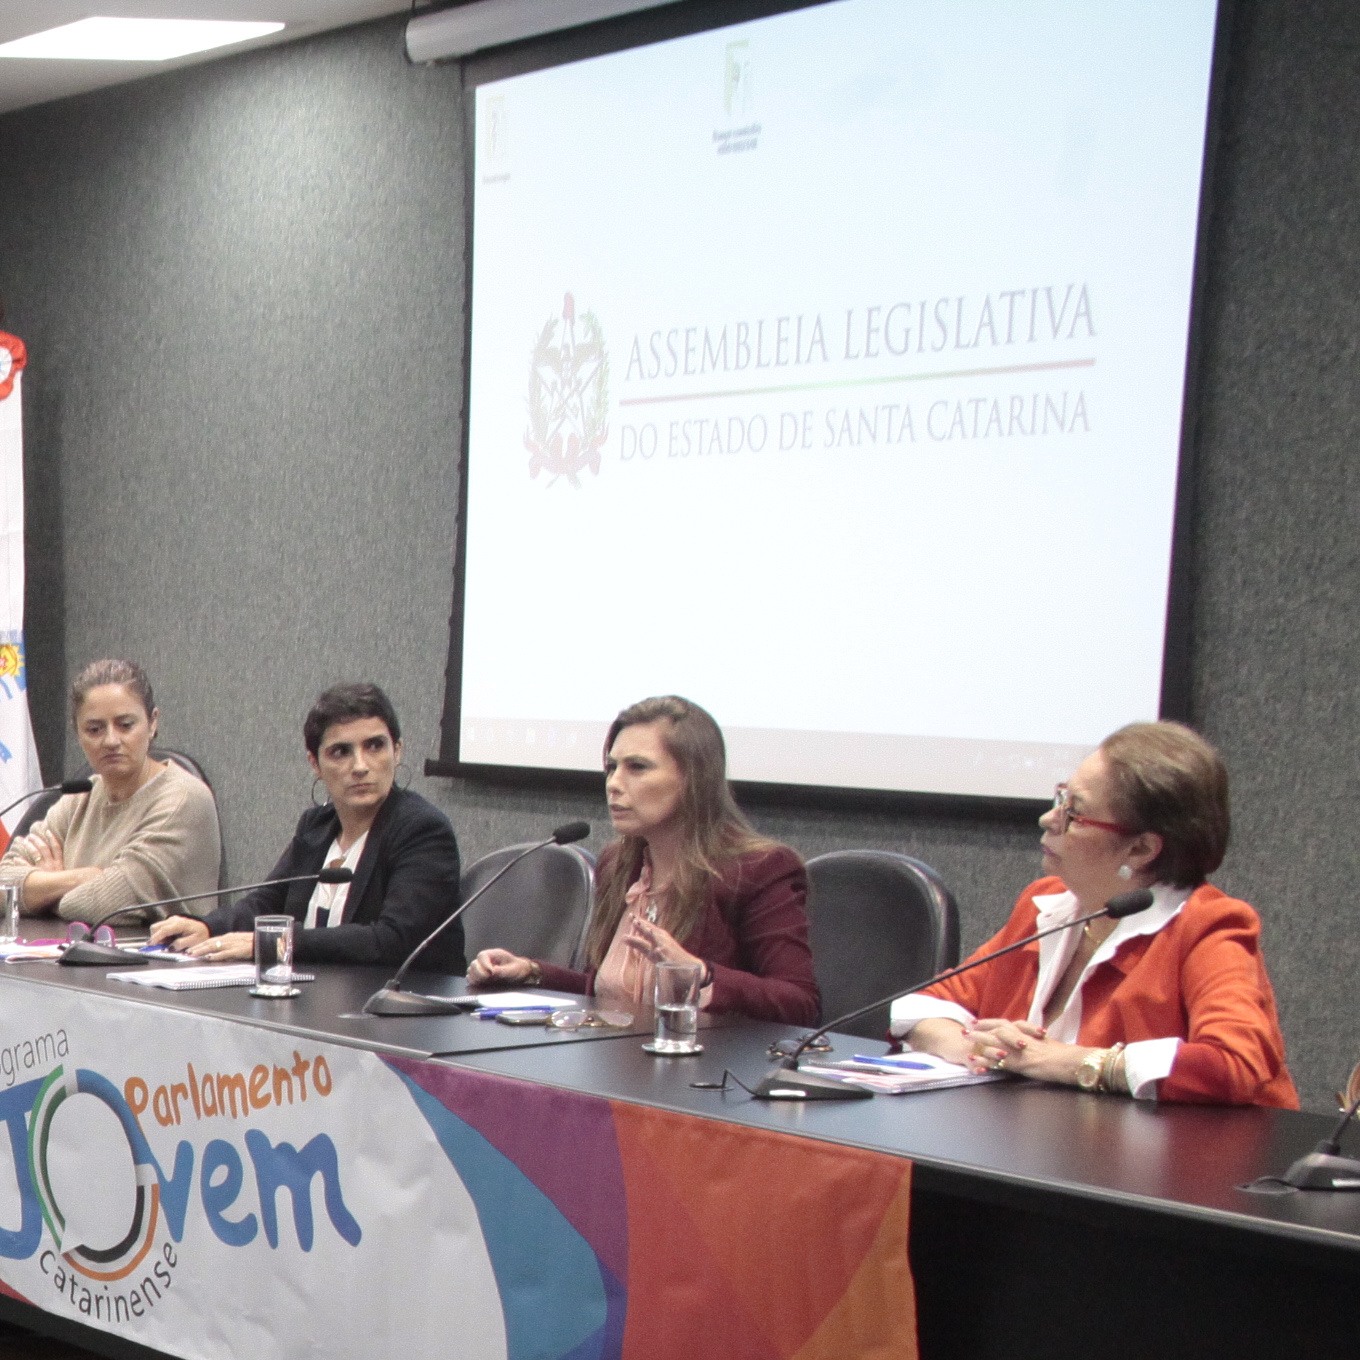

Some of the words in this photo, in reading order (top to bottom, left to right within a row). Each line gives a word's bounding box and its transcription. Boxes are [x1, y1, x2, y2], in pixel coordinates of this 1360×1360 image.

[625, 312, 829, 382] ASSEMBLEIA
[843, 281, 1097, 360] LEGISLATIVA
[620, 422, 657, 462] DO
[668, 412, 767, 459] ESTADO
[779, 409, 813, 452] DE
[823, 402, 916, 449] SANTA
[927, 390, 1091, 443] CATARINA
[124, 1050, 333, 1141] Parlamento
